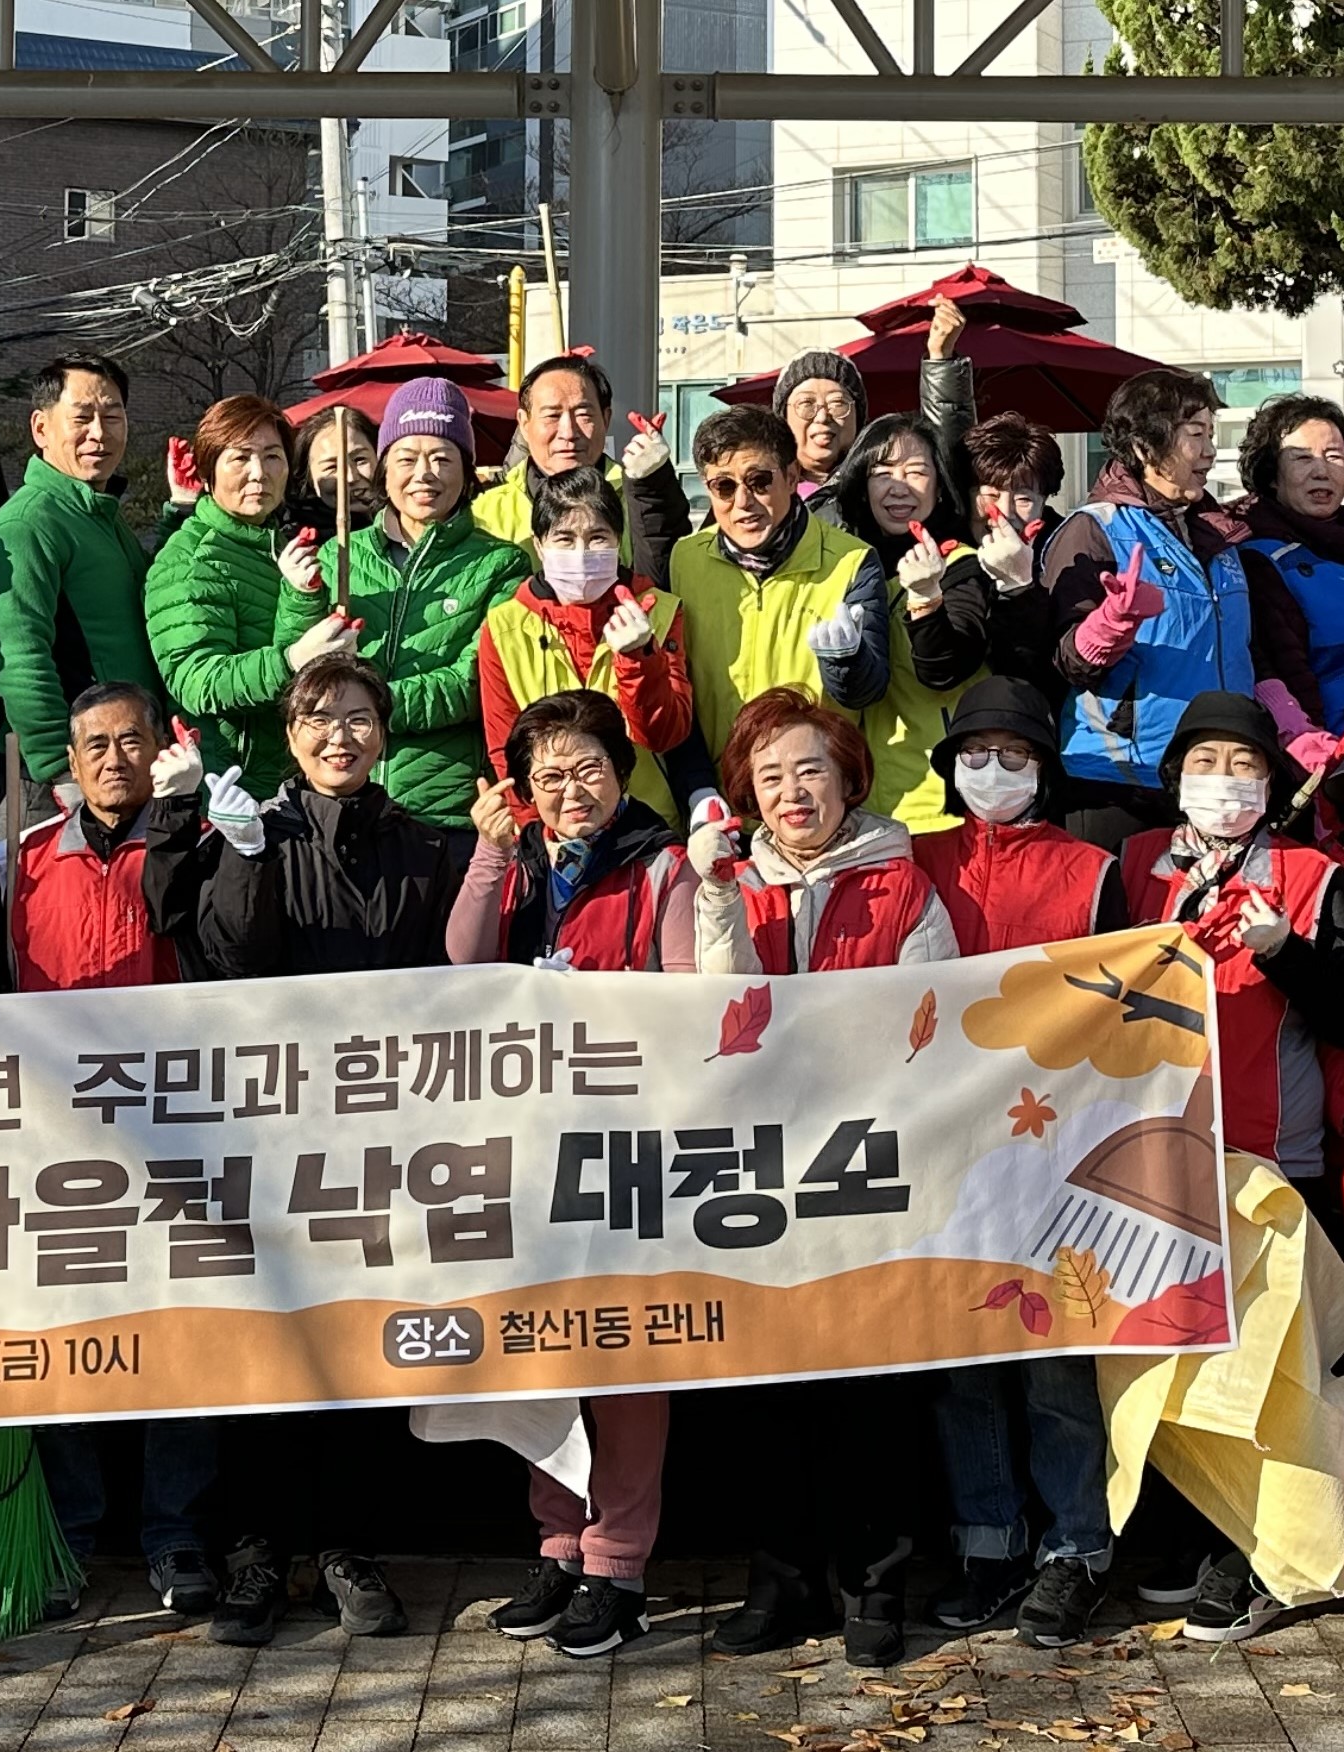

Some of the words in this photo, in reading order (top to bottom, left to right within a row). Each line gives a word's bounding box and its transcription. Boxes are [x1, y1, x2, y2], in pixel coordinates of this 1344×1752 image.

[71, 1037, 310, 1126] 주민과
[333, 1022, 644, 1115] 함께하는
[287, 1136, 514, 1268] 낙엽
[549, 1117, 912, 1250] 대청소
[65, 1333, 140, 1376] 10시
[395, 1315, 471, 1361] 장소
[498, 1306, 633, 1354] 철산1동
[644, 1300, 726, 1346] 관내
